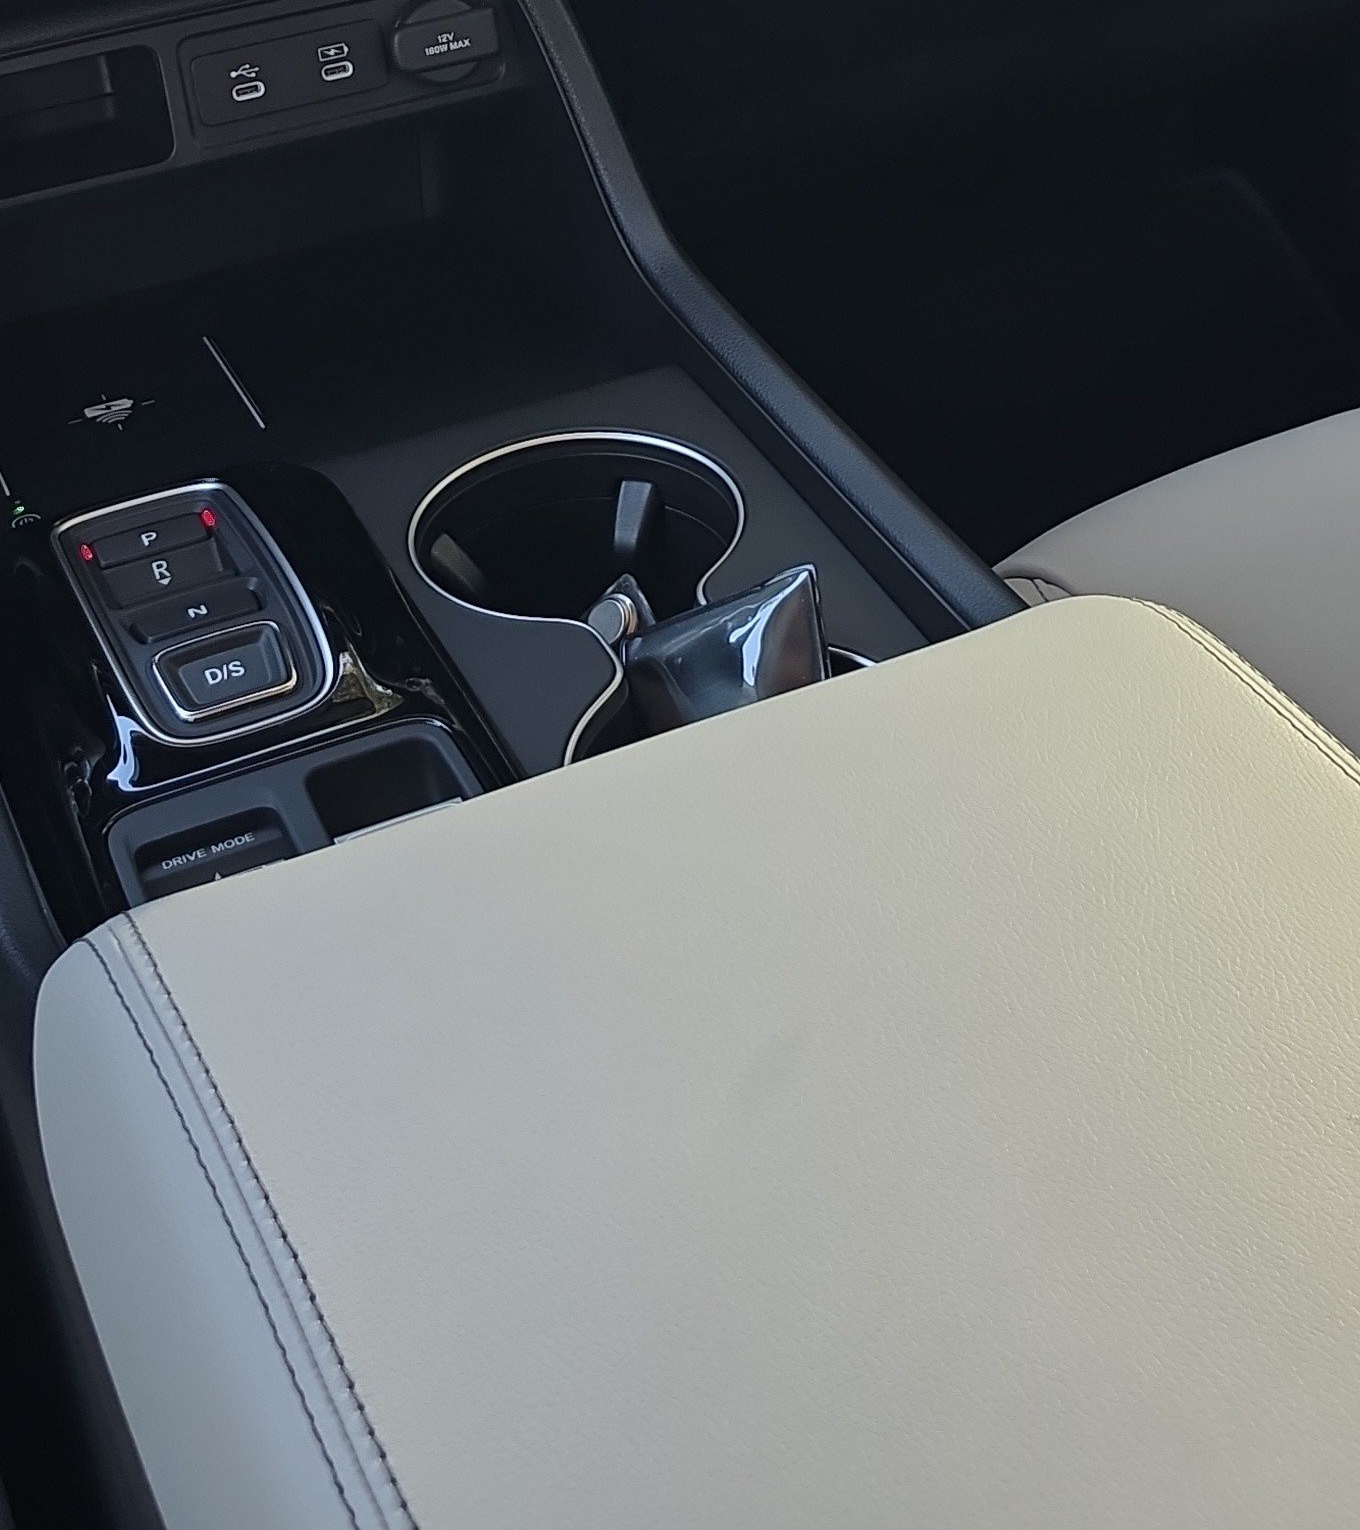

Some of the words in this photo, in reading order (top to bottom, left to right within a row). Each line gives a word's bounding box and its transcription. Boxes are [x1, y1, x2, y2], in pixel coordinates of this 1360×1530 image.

[437, 32, 454, 43] 12V
[449, 38, 471, 50] MAX
[140, 531, 158, 546] P
[152, 560, 171, 580] R
[204, 660, 245, 684] D/S
[161, 848, 207, 870] DRIVE
[211, 832, 255, 853] MODE
